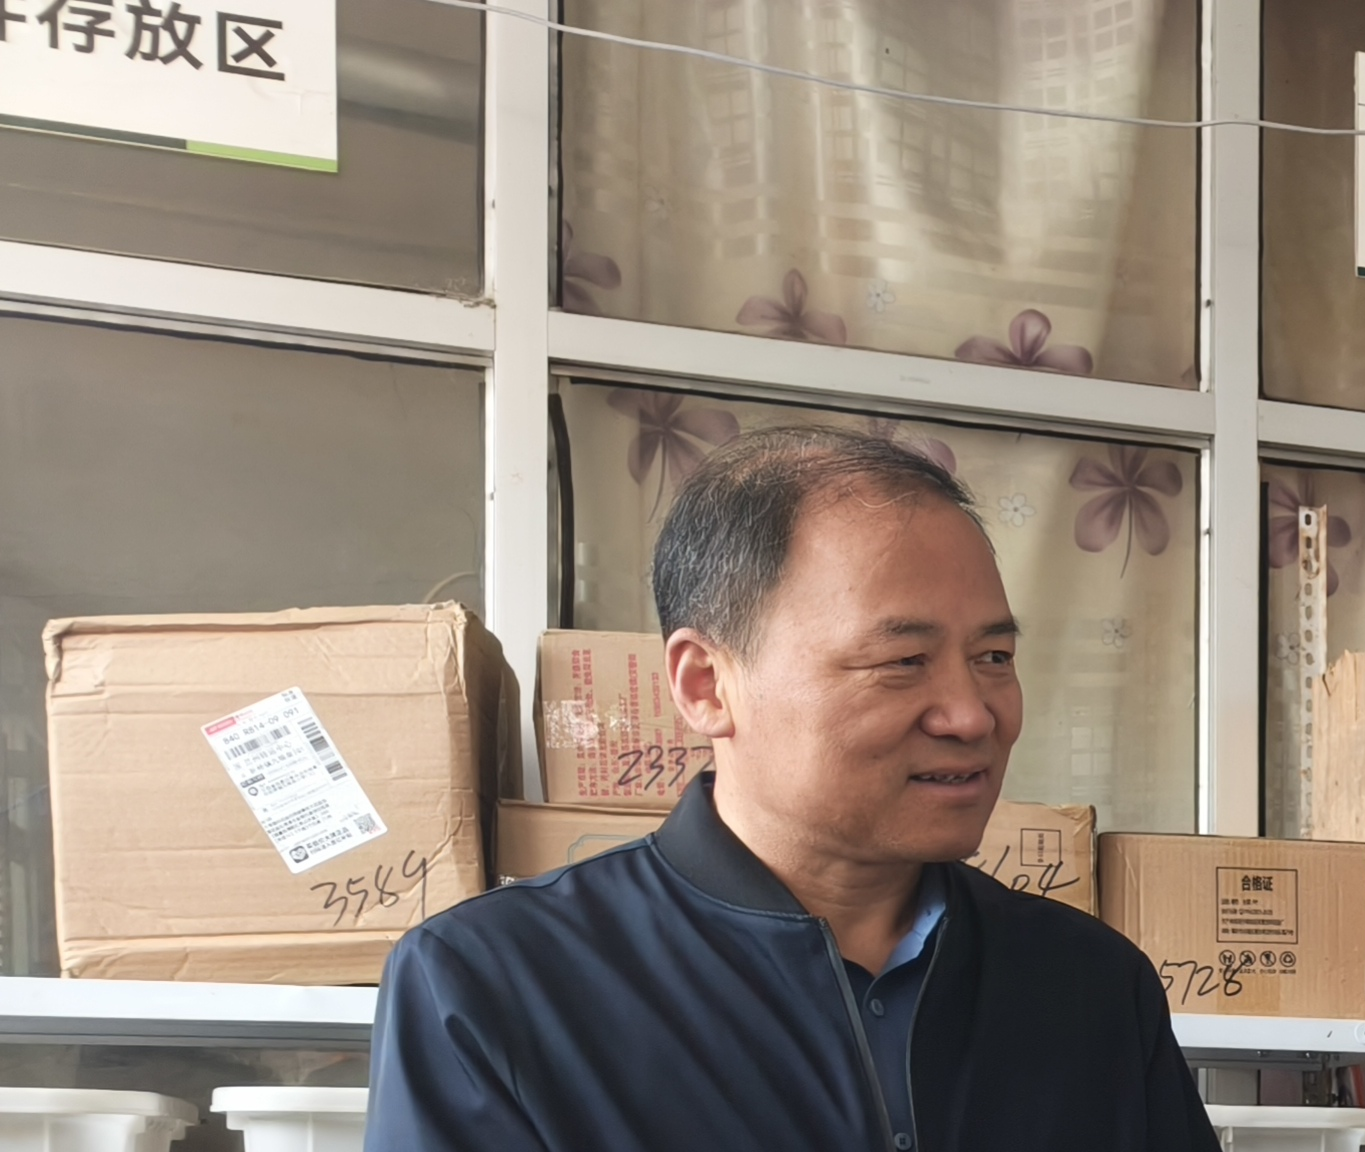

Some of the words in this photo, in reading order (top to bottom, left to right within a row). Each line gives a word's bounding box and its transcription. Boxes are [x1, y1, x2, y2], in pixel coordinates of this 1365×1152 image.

[1241, 875, 1274, 892] 合格证
[1159, 958, 1244, 1006] 5728
